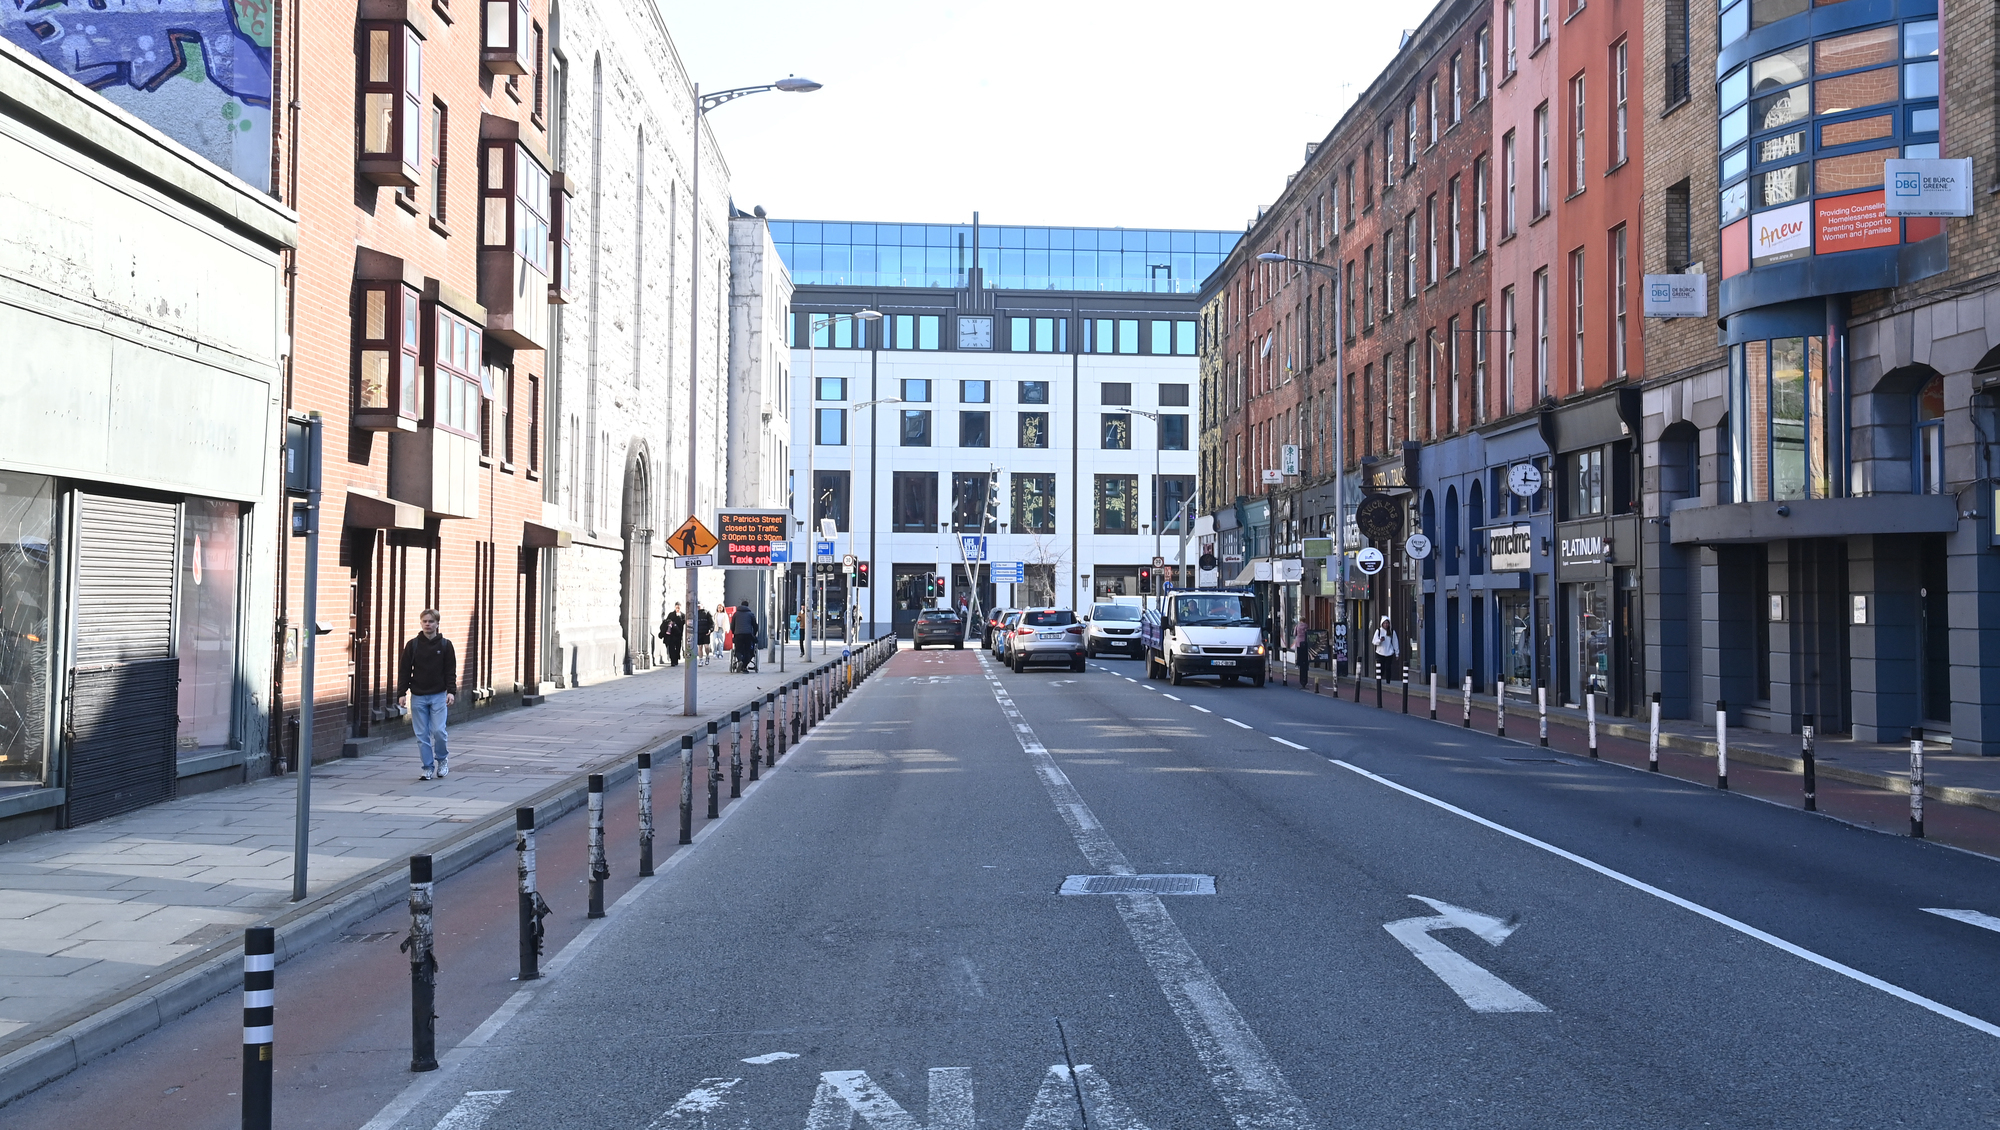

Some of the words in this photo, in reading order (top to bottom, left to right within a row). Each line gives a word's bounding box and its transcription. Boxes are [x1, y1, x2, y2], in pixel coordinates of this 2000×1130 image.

[1895, 180, 1918, 189] DBG
[1933, 175, 1955, 183] BÚRCA
[1820, 207, 1850, 218] Providing
[1851, 202, 1886, 213] Counsellin
[1828, 212, 1877, 224] Homelessness
[1822, 222, 1854, 234] Parenting
[1855, 219, 1883, 230] Support
[1759, 220, 1803, 248] Anew
[1822, 232, 1848, 242] Women
[1849, 230, 1862, 238] and
[1864, 226, 1892, 237] Families
[1651, 289, 1668, 297] DBG
[721, 515, 731, 523] St.
[733, 515, 760, 523] Patricks
[762, 516, 783, 524] Street
[721, 533, 748, 542] 3:00pm
[728, 543, 756, 553] Buses
[1561, 536, 1601, 557] PLATINUM
[730, 555, 754, 564] Taxis
[755, 555, 773, 567] only
